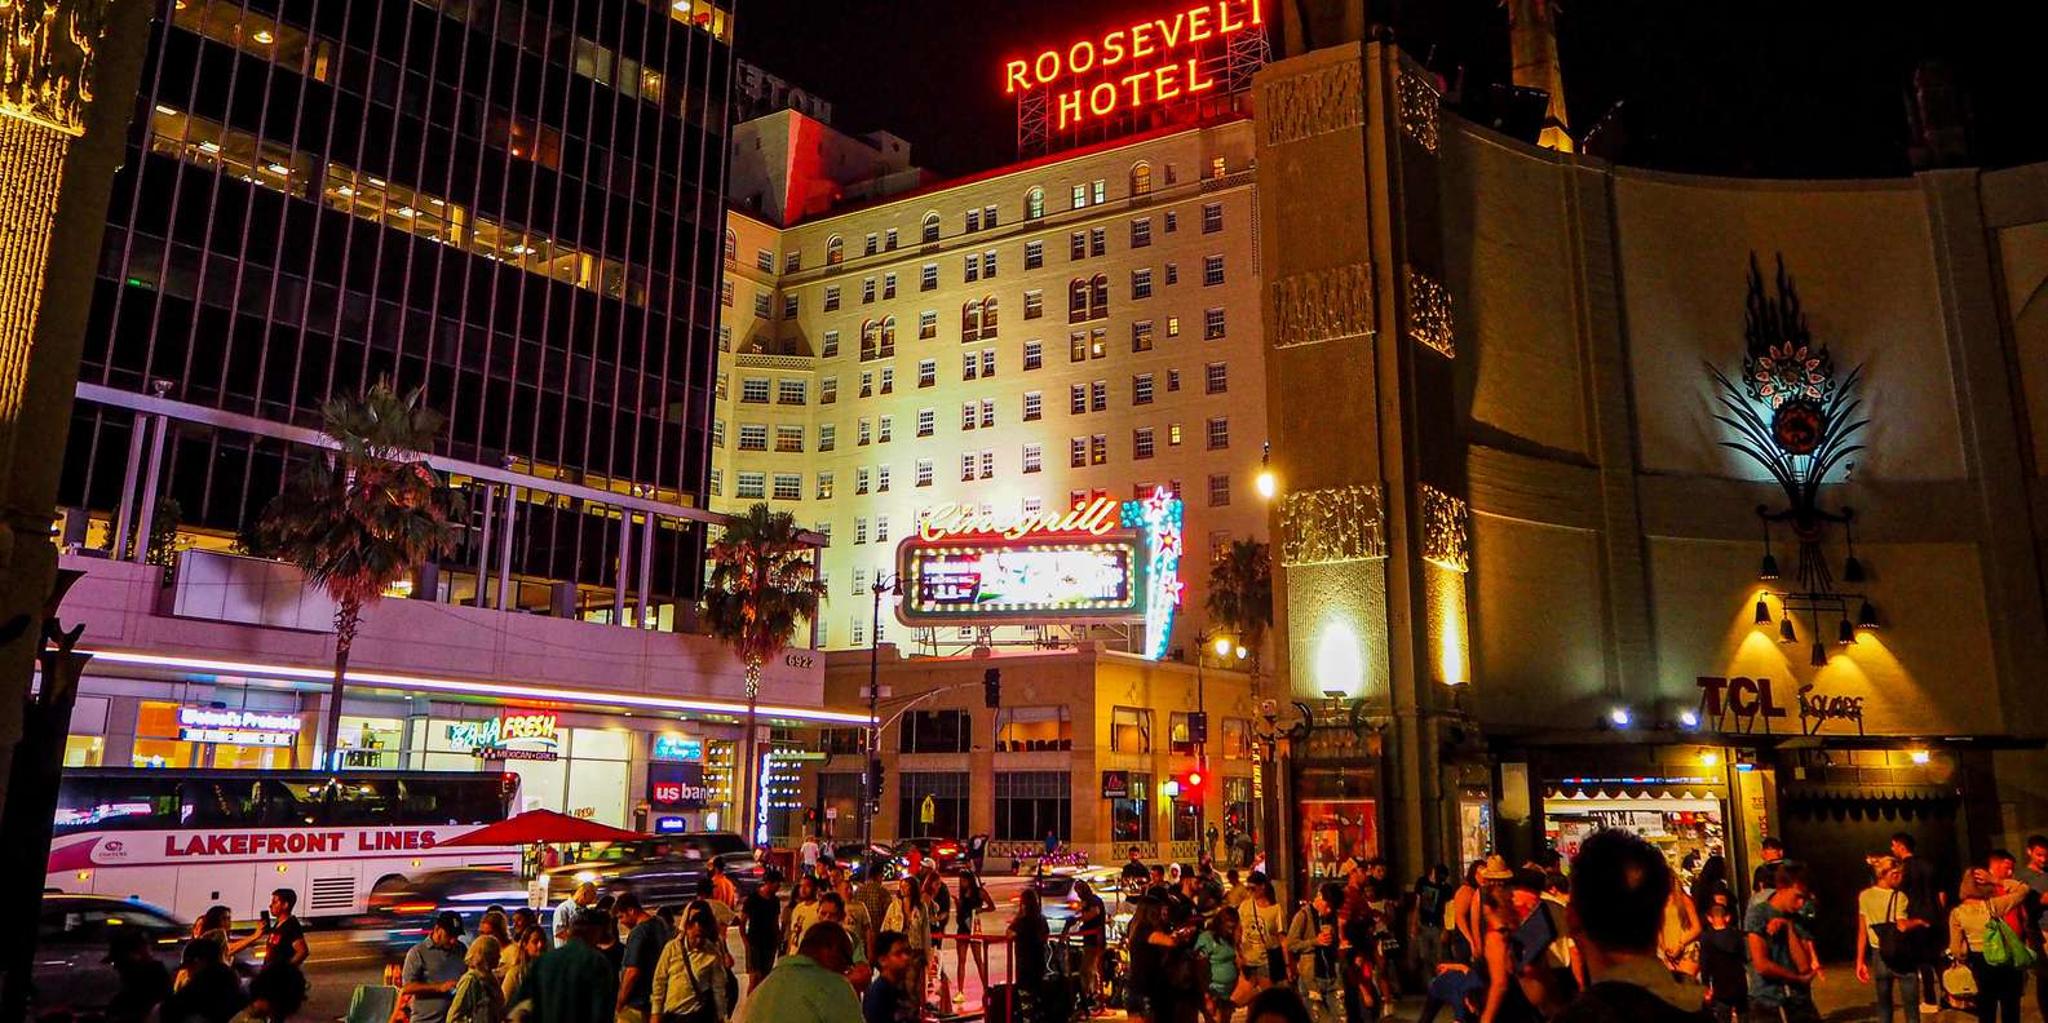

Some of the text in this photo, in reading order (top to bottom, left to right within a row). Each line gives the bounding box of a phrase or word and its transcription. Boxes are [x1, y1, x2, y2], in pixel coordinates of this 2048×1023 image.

[1006, 0, 1263, 93] ROOSEVELT
[1059, 58, 1214, 130] HOTEL
[786, 653, 814, 669] 6922
[1696, 676, 1787, 718] TCL
[452, 714, 556, 746] BAJA FRESH
[164, 830, 437, 857] LAKEFRONT LINES
